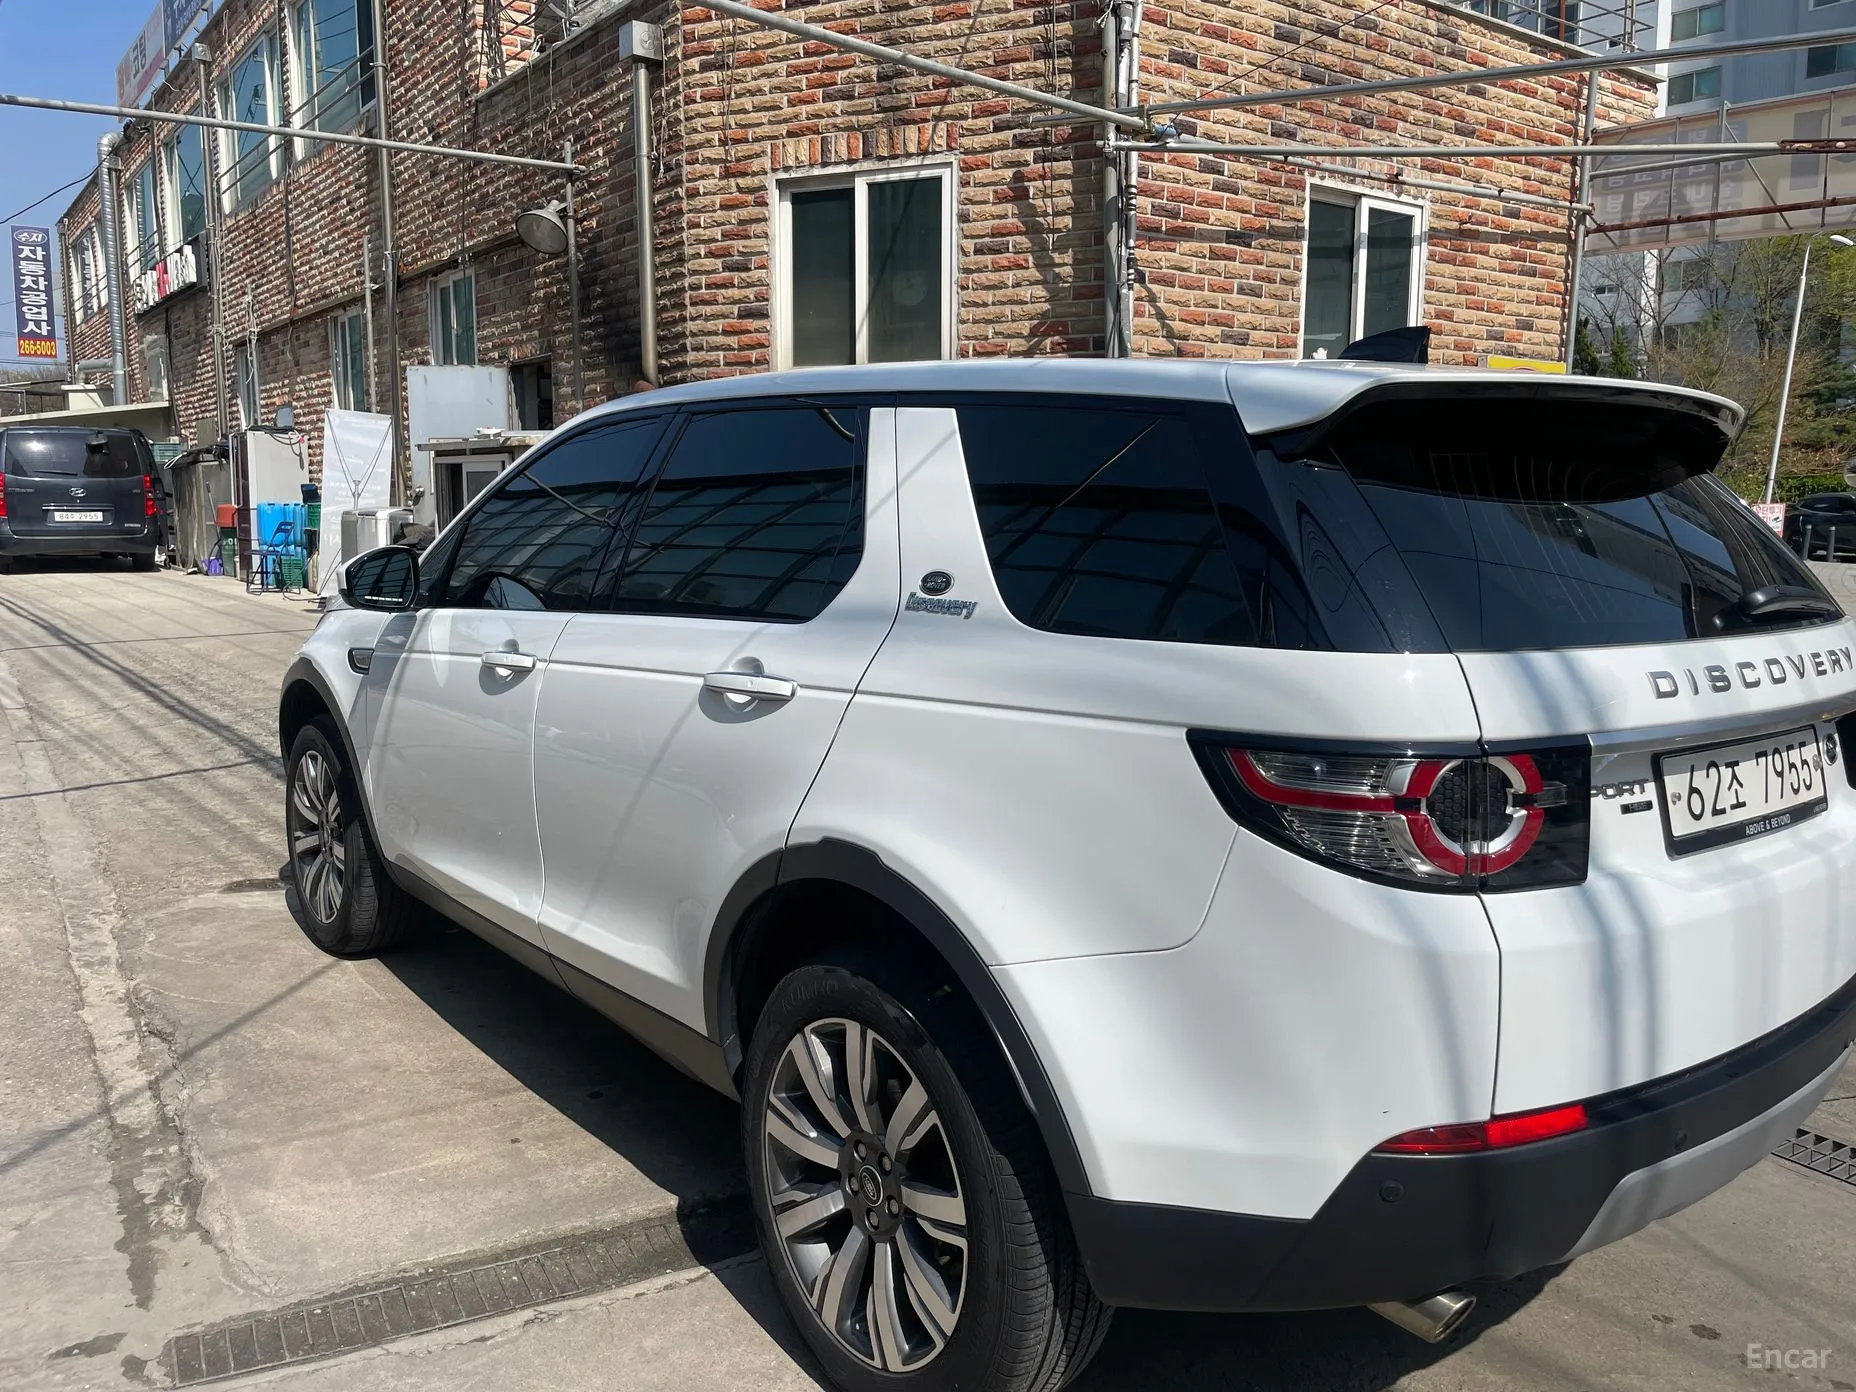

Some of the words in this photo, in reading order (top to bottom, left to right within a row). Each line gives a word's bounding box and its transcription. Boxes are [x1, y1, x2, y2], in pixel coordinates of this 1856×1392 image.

[17, 245, 51, 336] 자동차공업사
[19, 340, 56, 355] 266-5003
[1645, 646, 1854, 700] DISCOVERY
[1686, 759, 1747, 822] 62조
[1755, 741, 1813, 804] 7955
[1745, 821, 1765, 836] ABOVE
[1770, 813, 1791, 829] BEYOND
